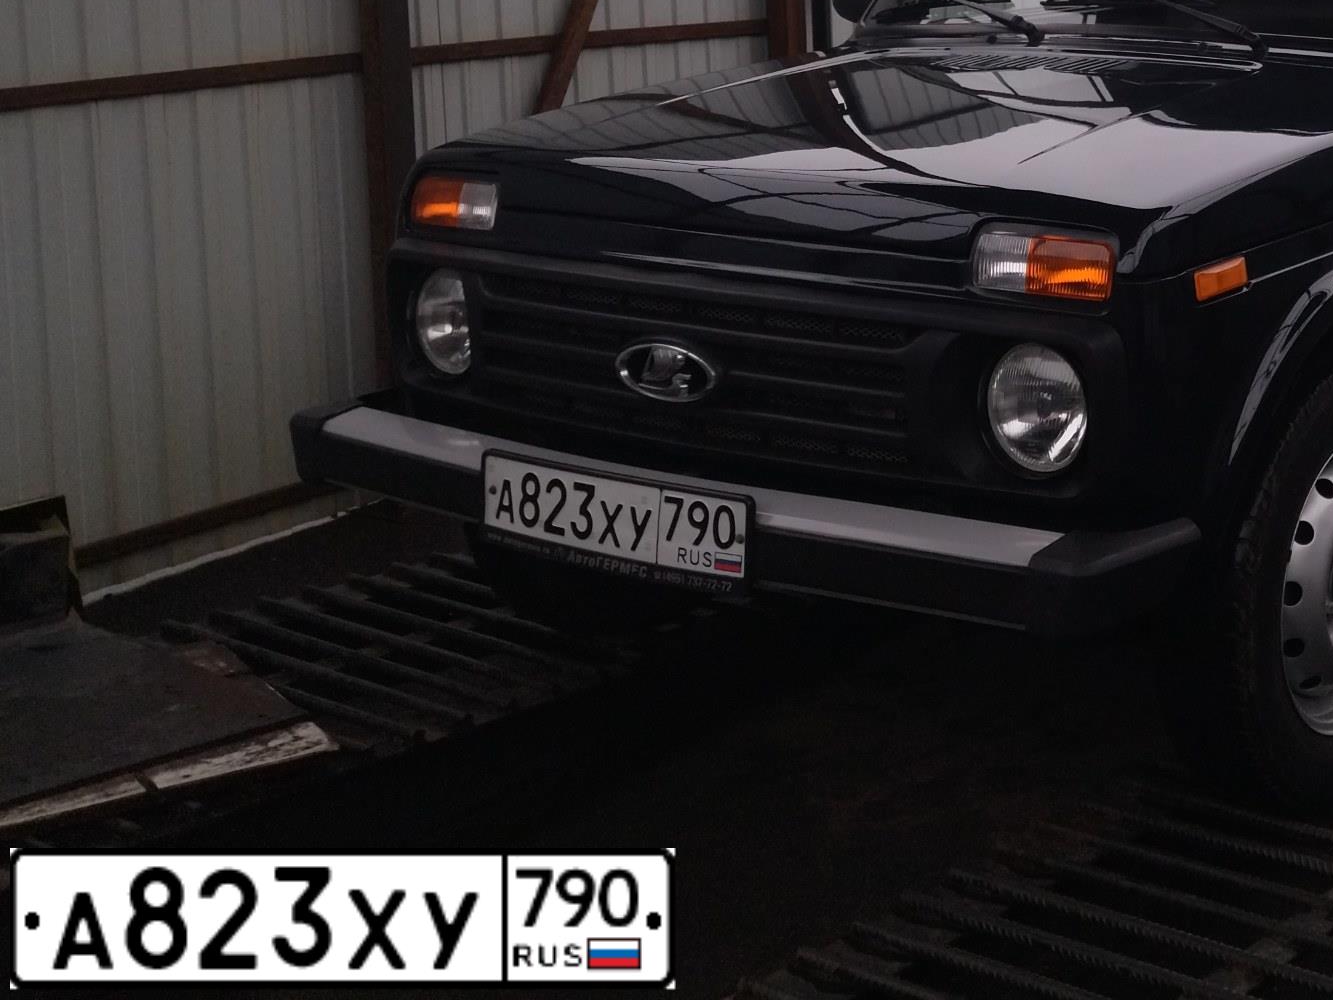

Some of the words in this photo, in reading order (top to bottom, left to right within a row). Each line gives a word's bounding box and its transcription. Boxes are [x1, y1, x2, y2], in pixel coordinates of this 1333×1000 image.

[495, 471, 652, 552] А823ХУ
[663, 496, 736, 550] 790
[677, 547, 713, 568] RUS
